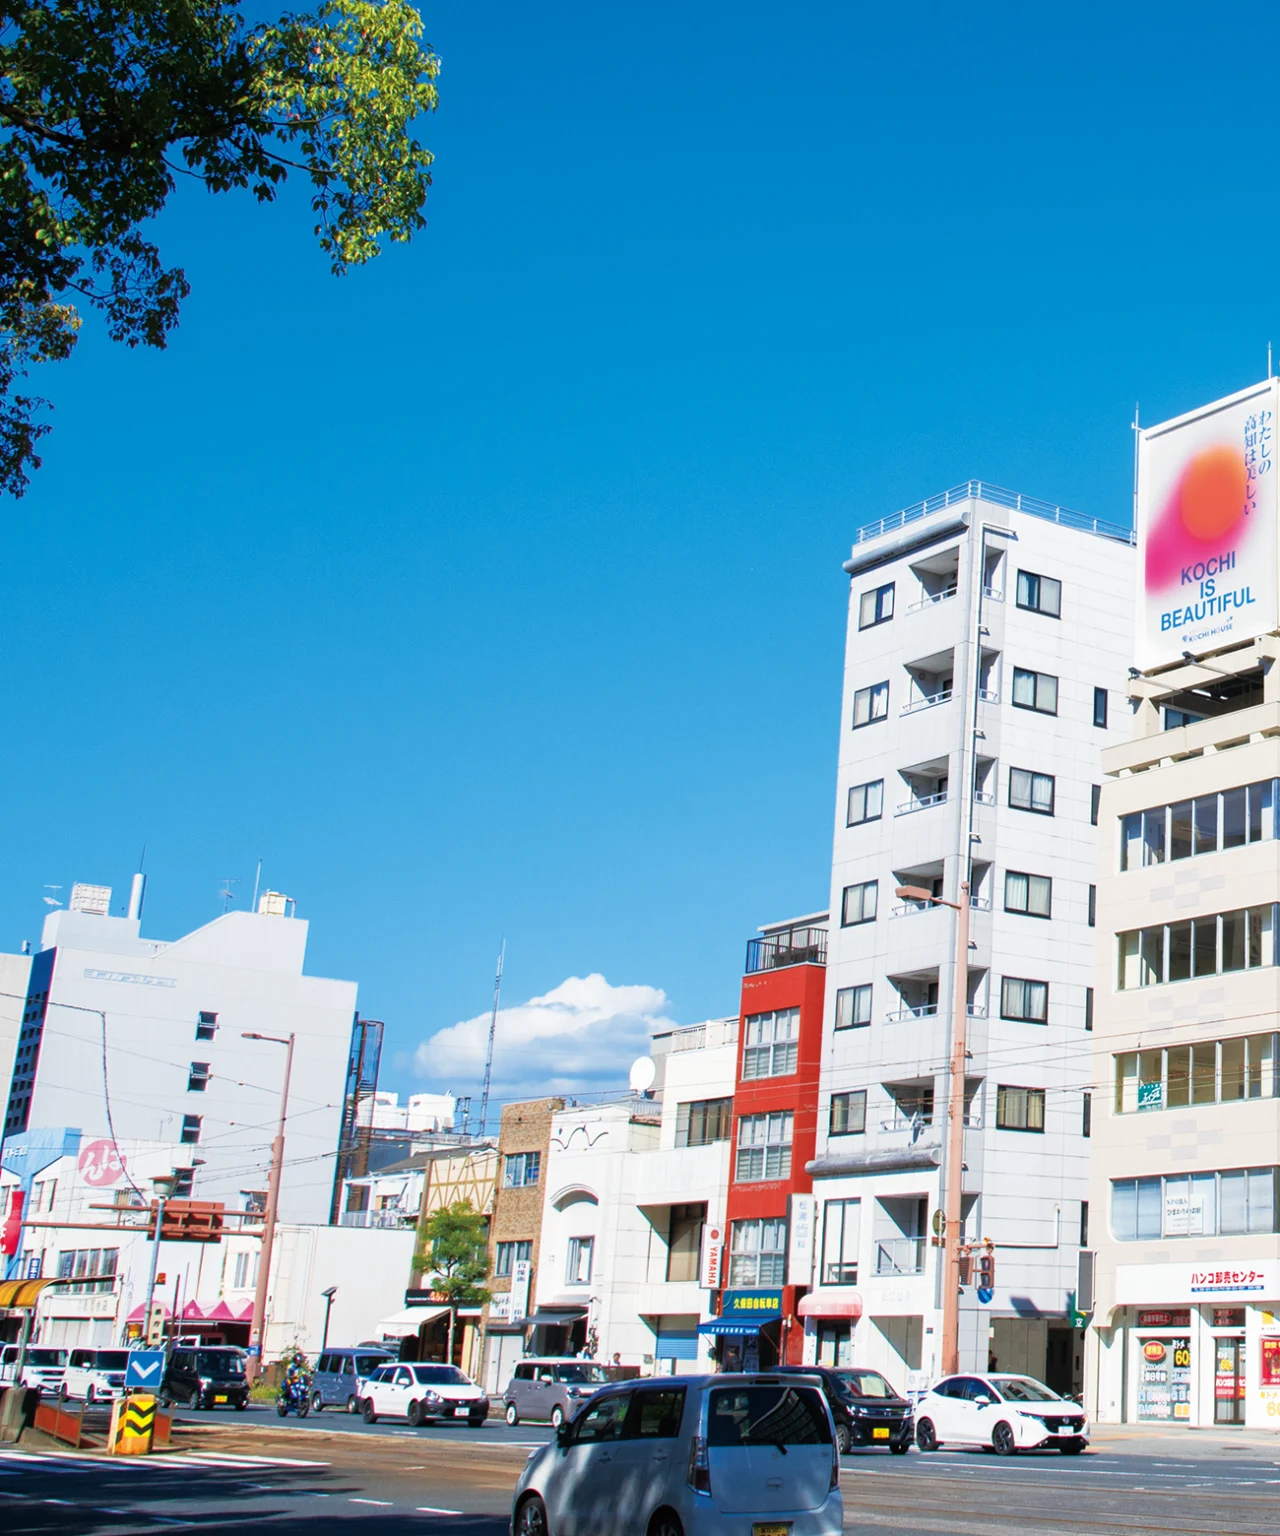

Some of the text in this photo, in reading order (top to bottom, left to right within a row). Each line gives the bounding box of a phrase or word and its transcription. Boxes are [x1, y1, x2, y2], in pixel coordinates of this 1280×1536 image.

[1258, 410, 1272, 475] わたしの
[1244, 415, 1257, 515] 高知は美しい
[1181, 550, 1236, 586] KOCHI
[1200, 578, 1216, 599] IS
[1161, 586, 1256, 631] BEAUTIFUL
[1188, 623, 1233, 642] KOCHI HOUSE
[707, 1246, 717, 1285] YAMAHA
[1191, 1270, 1265, 1285] ハンコ卸売センター
[733, 1297, 779, 1309] 久保田自転車店
